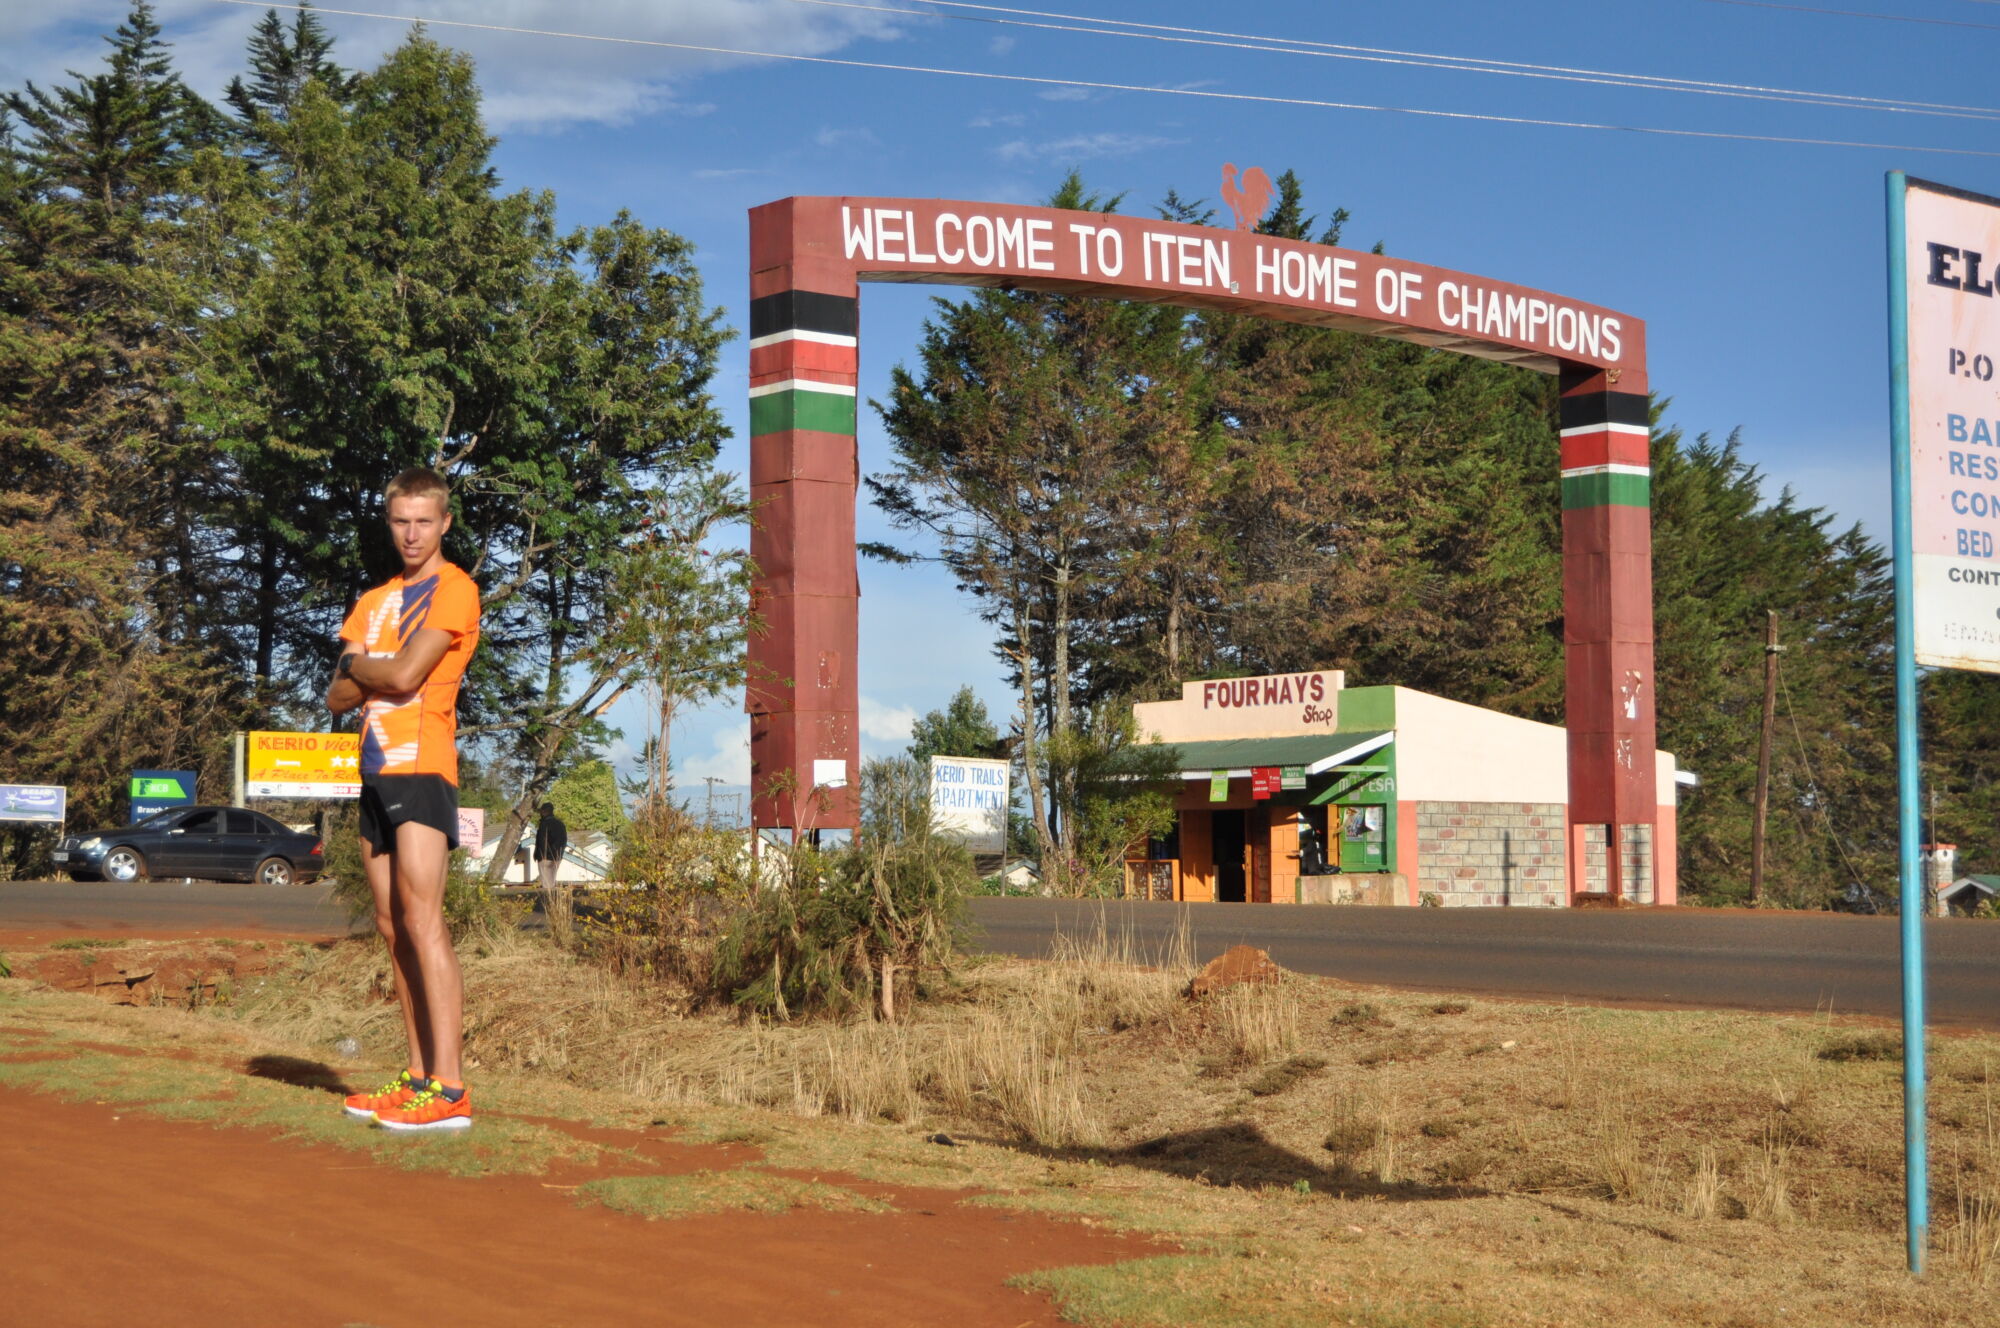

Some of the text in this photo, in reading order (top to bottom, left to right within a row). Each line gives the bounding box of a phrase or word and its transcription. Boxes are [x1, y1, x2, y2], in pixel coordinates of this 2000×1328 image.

[1926, 241, 2000, 298] EL
[842, 206, 1621, 362] WELCOME TO ITEN HOME OF CHAMPIONS
[1947, 413, 2000, 447] BA
[1957, 528, 1993, 558] BED
[1302, 704, 1332, 726] Shop
[258, 736, 318, 751] KERIO
[936, 764, 1004, 786] KERIO TRAILS
[935, 787, 1005, 810] APARTMENT
